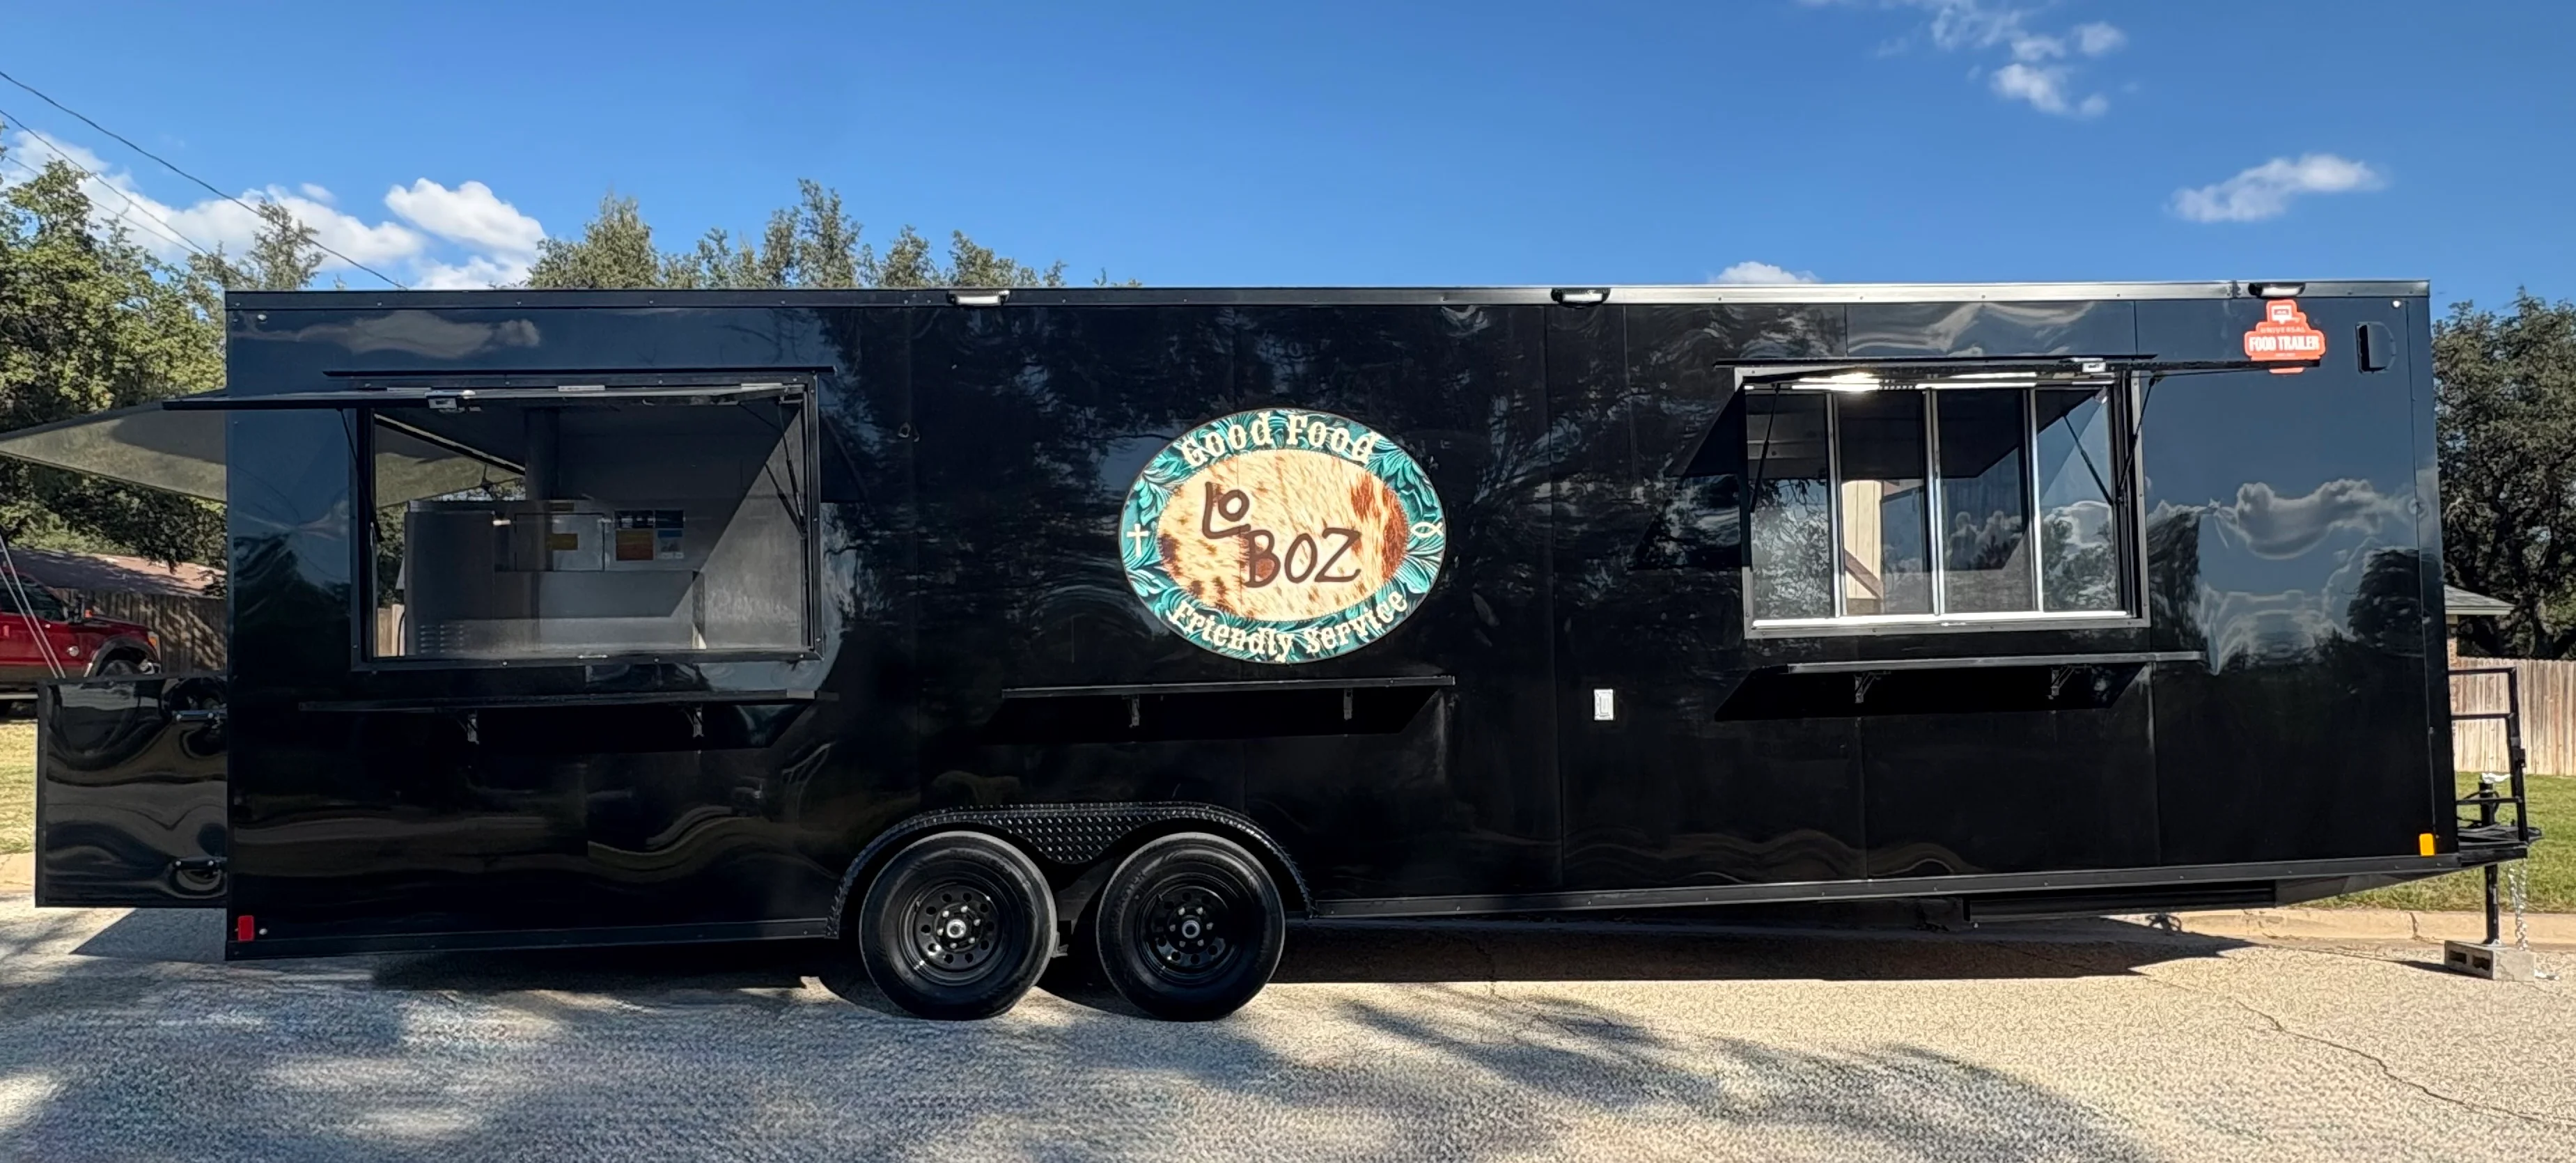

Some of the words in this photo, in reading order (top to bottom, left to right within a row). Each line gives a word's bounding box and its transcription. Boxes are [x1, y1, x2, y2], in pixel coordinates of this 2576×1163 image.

[2249, 336, 2277, 352] FOOD
[2277, 335, 2320, 351] TRAILER
[1180, 412, 1273, 468] Good
[1286, 414, 1382, 465] Food
[1244, 526, 1361, 588] BOZ
[1168, 601, 1293, 662] Friendly
[1304, 591, 1407, 653] Service
